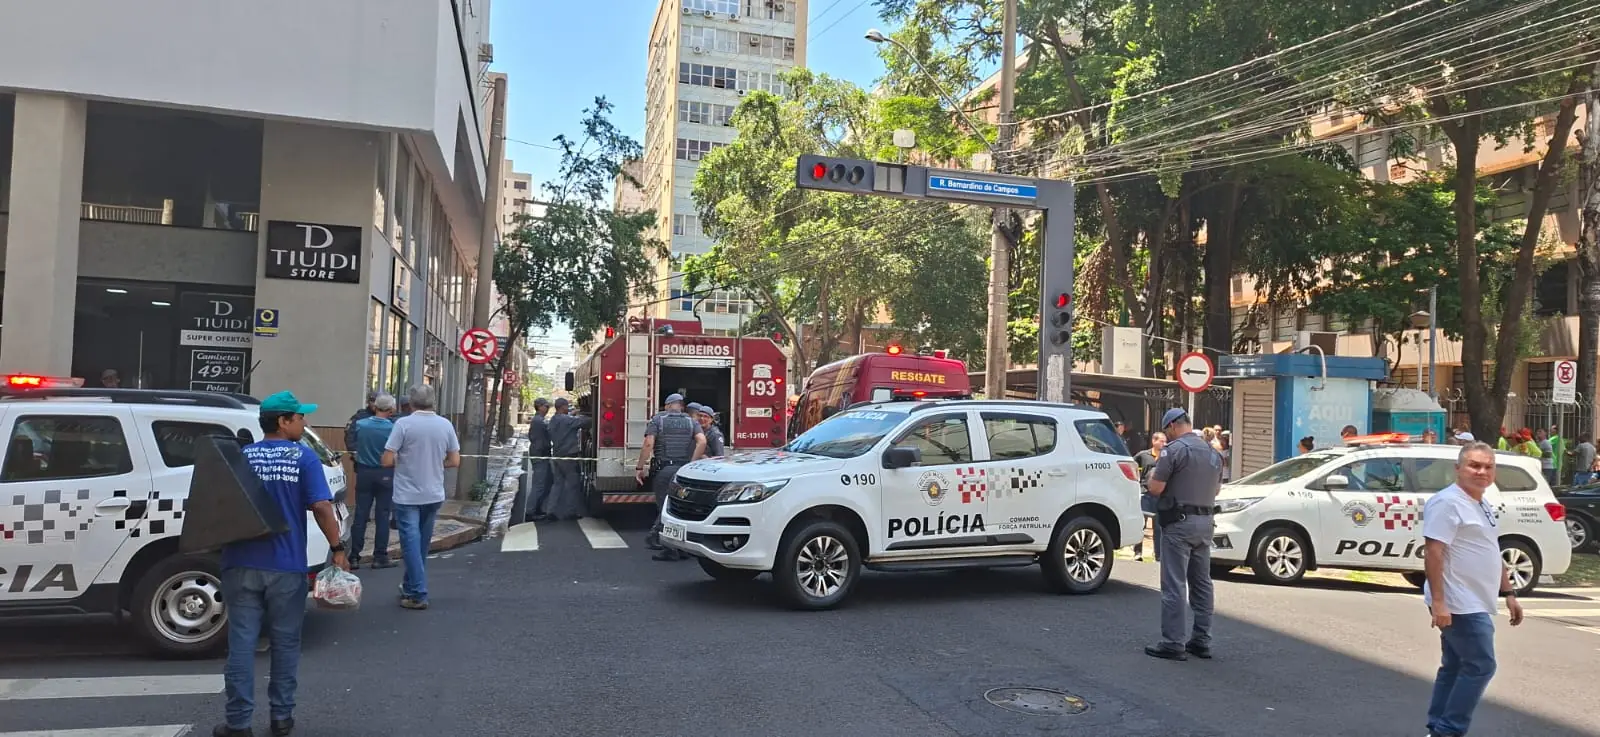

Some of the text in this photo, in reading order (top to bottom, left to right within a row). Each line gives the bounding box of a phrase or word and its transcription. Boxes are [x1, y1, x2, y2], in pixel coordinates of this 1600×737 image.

[939, 179, 946, 187] R.
[947, 180, 983, 191] Bernardino
[993, 183, 1019, 194] Campos
[270, 248, 357, 270] TIUIDI
[290, 268, 337, 279] STORE
[193, 316, 248, 329] TIUIDI
[196, 352, 240, 361] Camisetas
[662, 344, 730, 356] BOMBEIROS
[198, 365, 239, 378] 49,99
[891, 370, 946, 384] RESGATE
[206, 384, 228, 392] Polos
[747, 380, 776, 396] 193
[853, 473, 876, 486] 190
[887, 511, 986, 539] POLÍCIA
